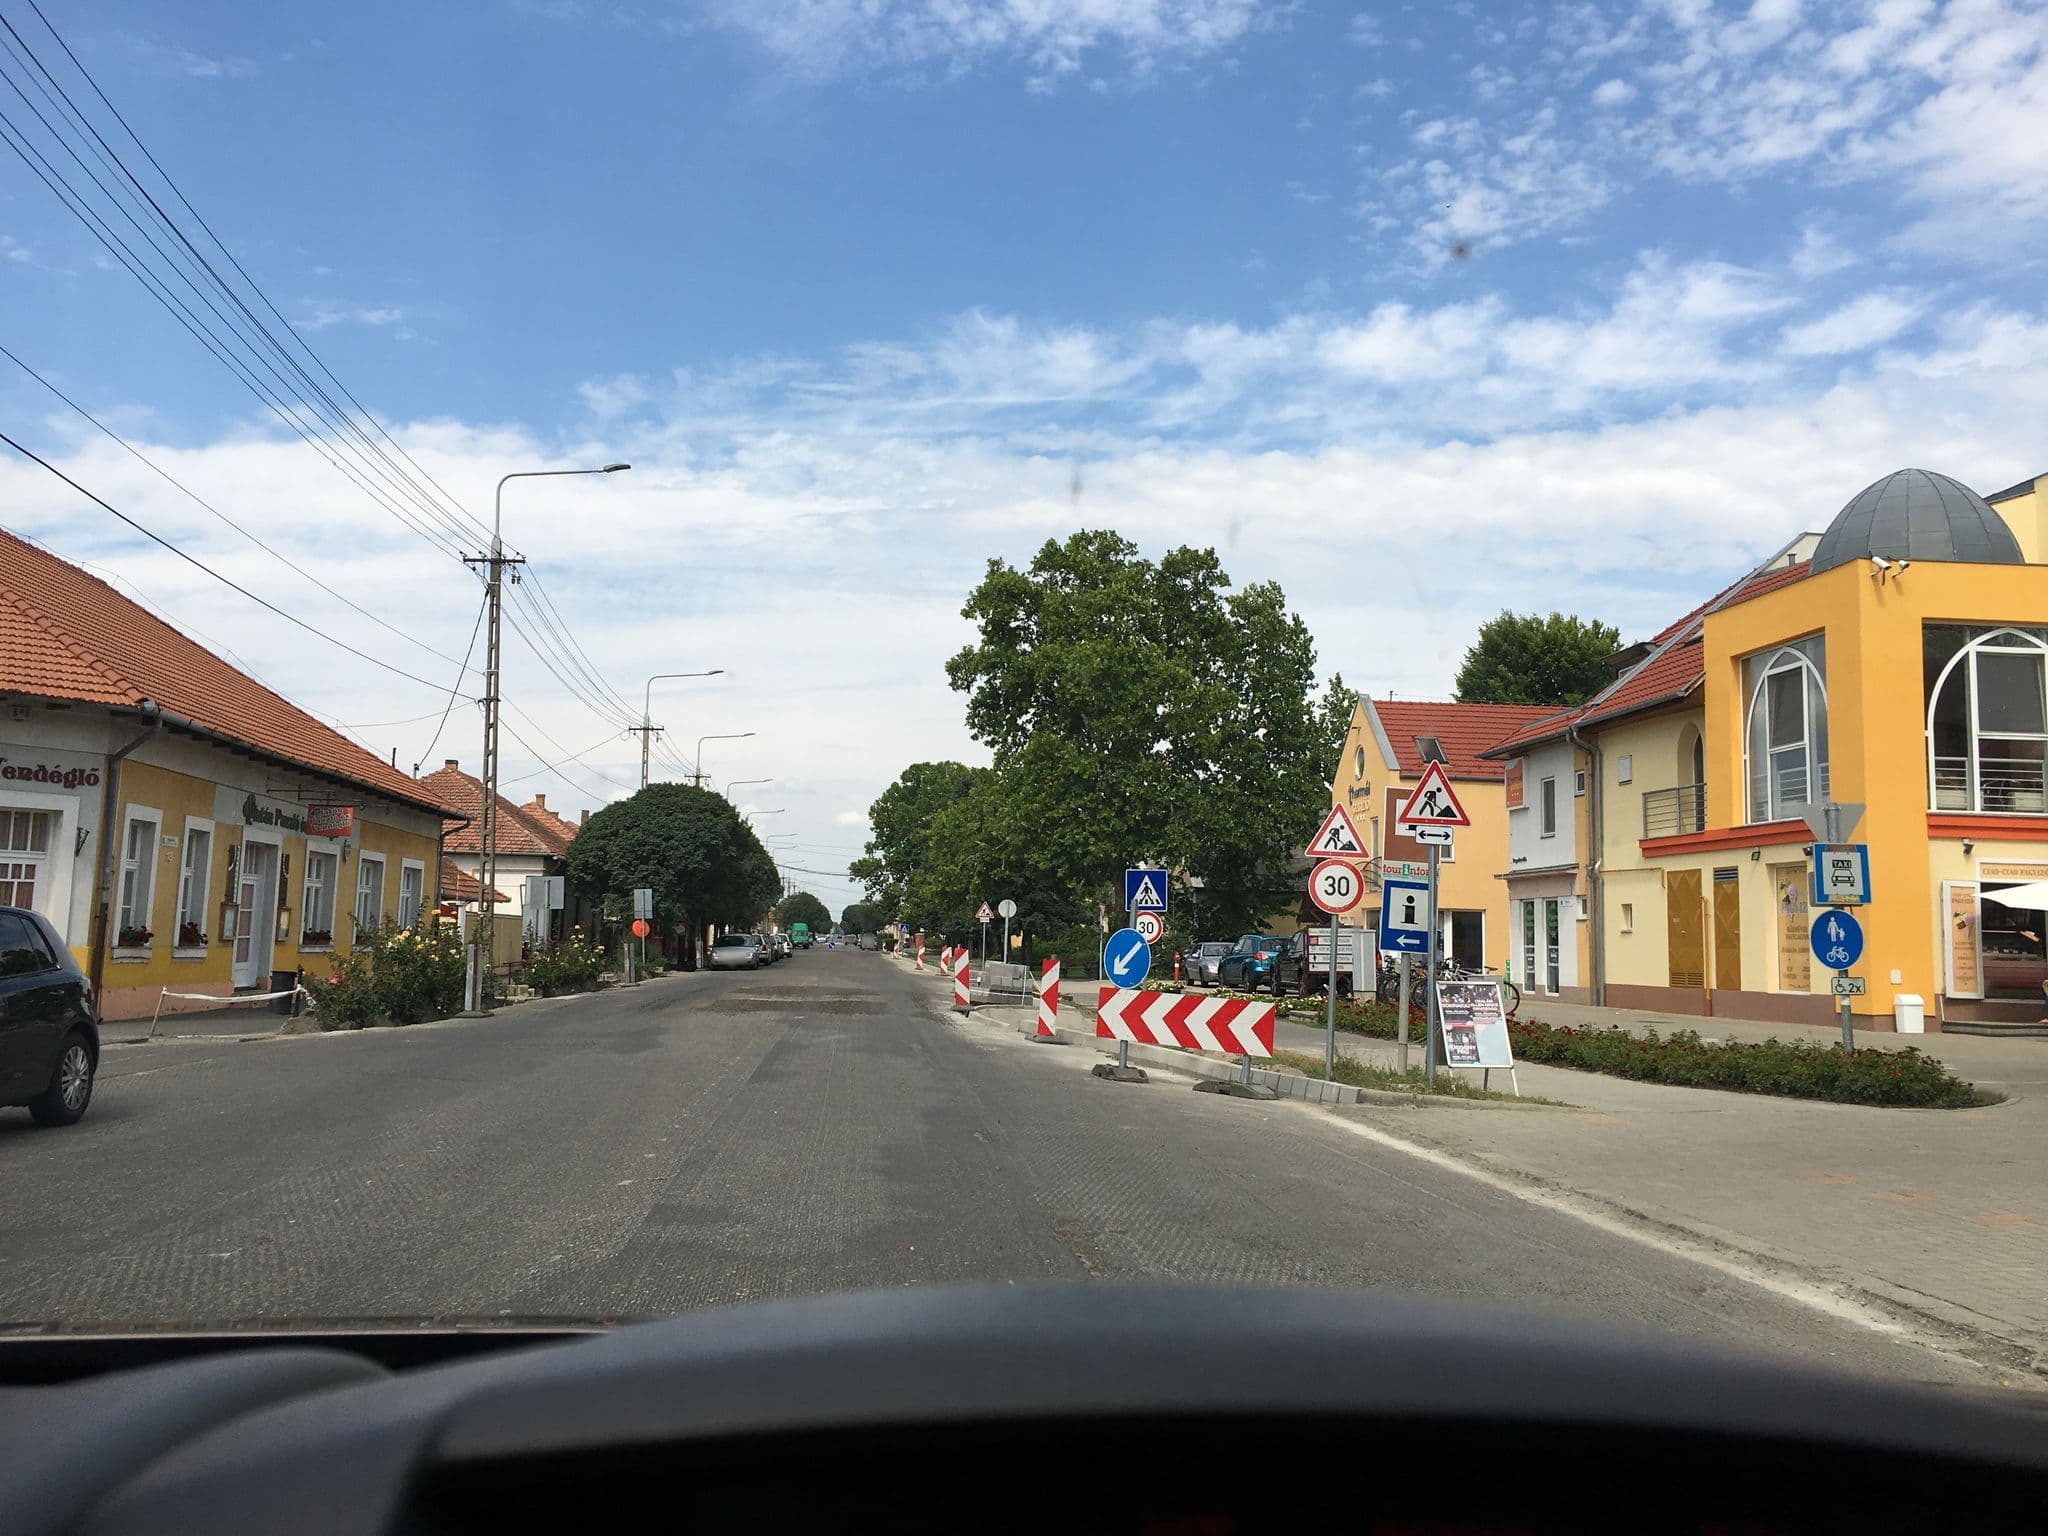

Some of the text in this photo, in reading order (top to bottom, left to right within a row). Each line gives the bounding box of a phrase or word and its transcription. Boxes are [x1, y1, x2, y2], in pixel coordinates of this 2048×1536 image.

[1833, 860, 1852, 868] TAXI
[1324, 875, 1350, 896] 30
[1138, 921, 1154, 934] 30
[1848, 982, 1862, 993] 2x
